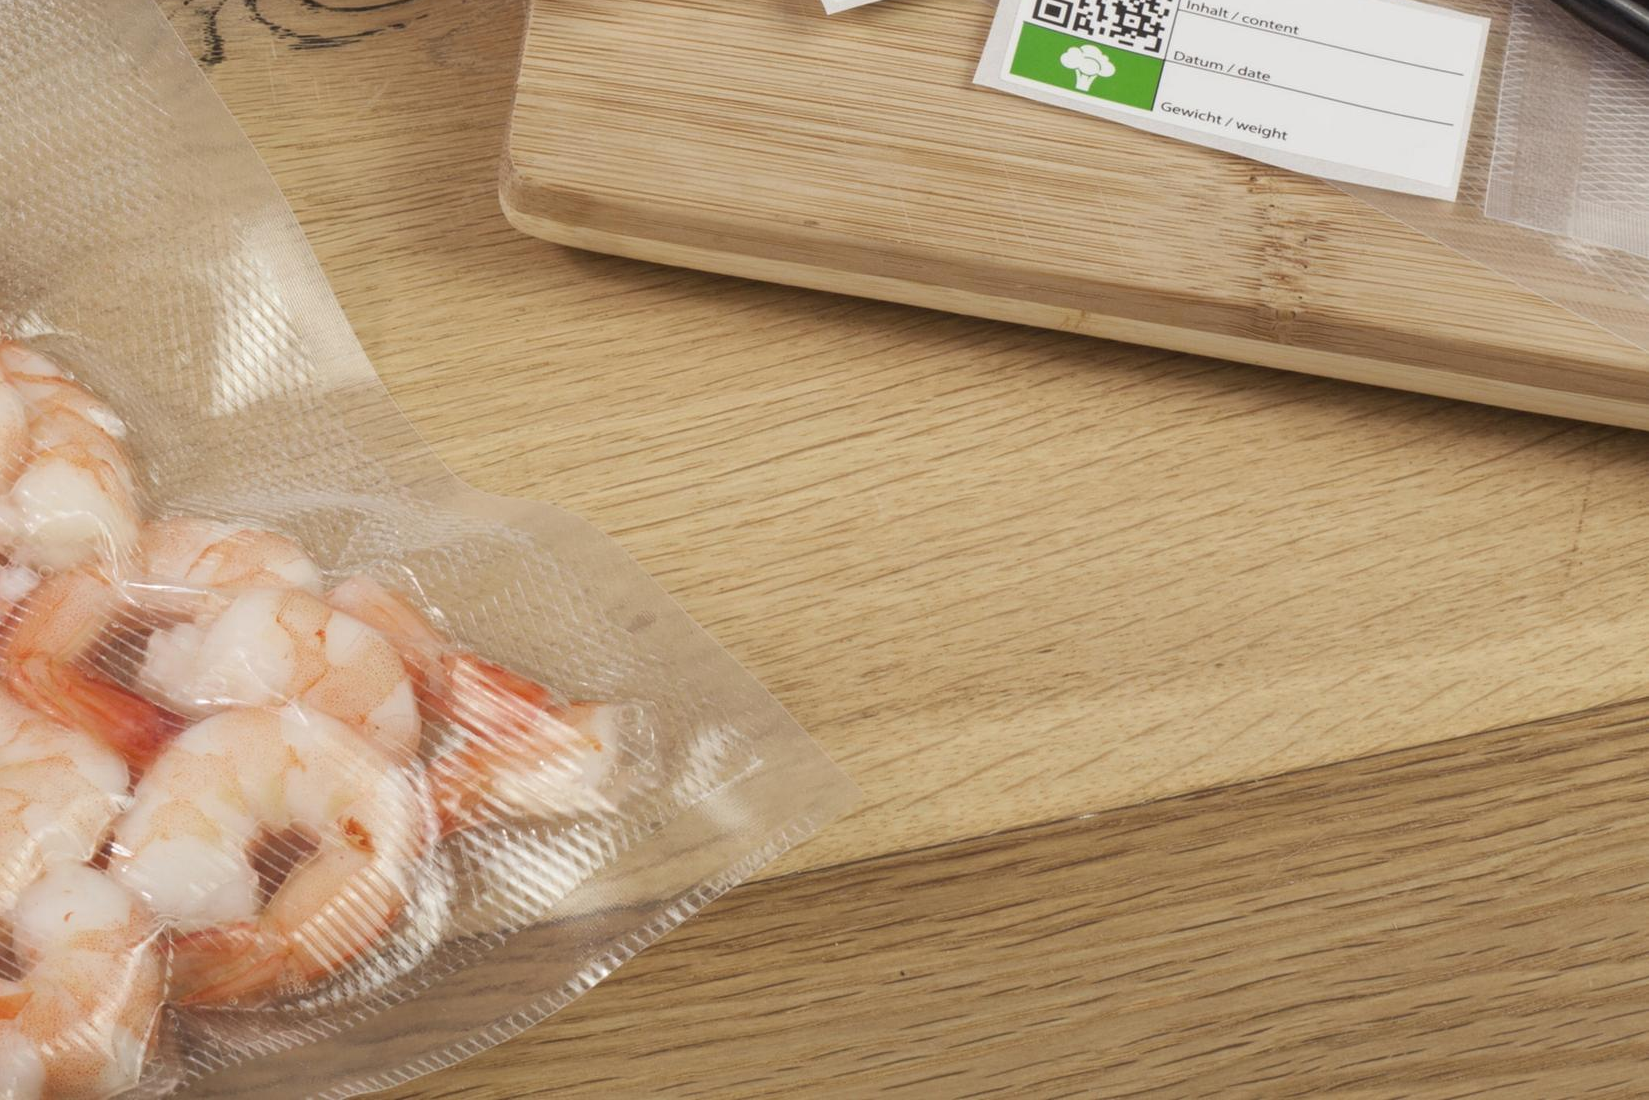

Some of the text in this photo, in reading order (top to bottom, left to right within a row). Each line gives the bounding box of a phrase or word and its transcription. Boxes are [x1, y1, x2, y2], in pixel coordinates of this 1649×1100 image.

[1186, 0, 1229, 19] Inhalt
[1242, 15, 1299, 35] content
[1173, 51, 1224, 71] Datum
[1238, 66, 1271, 81] date
[1161, 102, 1222, 125] Gewicht
[1236, 121, 1288, 141] weight
